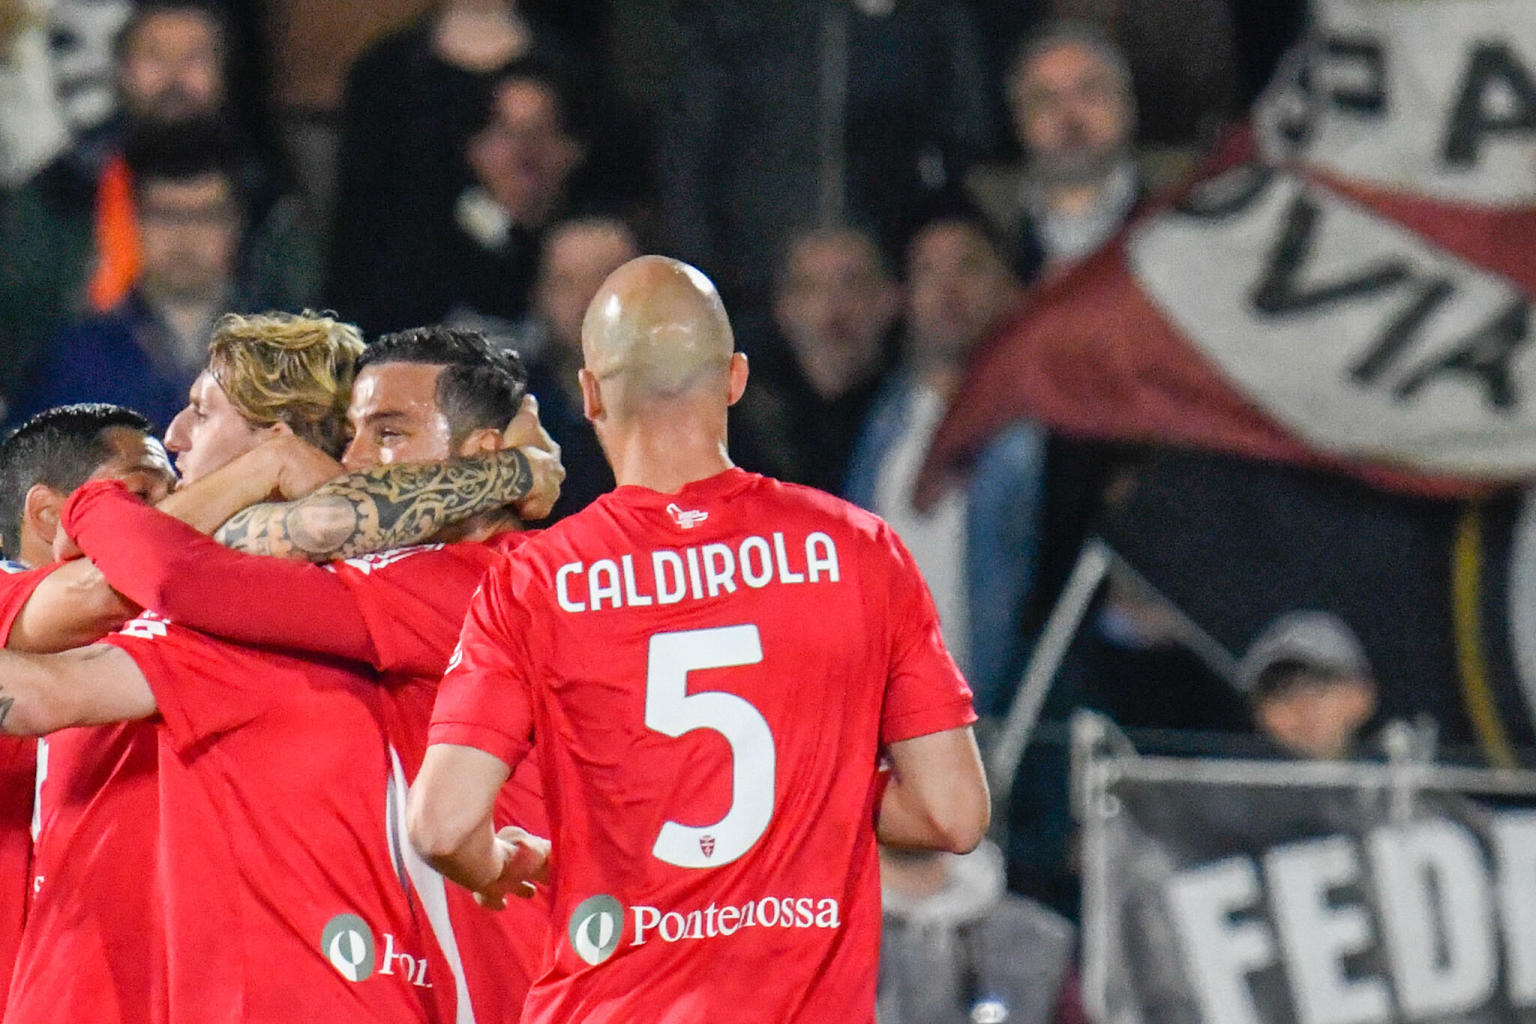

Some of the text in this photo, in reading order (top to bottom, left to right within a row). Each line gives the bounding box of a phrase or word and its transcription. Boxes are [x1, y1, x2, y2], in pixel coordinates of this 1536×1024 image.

[555, 531, 840, 613] CALDIROLA
[645, 623, 777, 868] 5
[629, 895, 840, 946] Pontenossa
